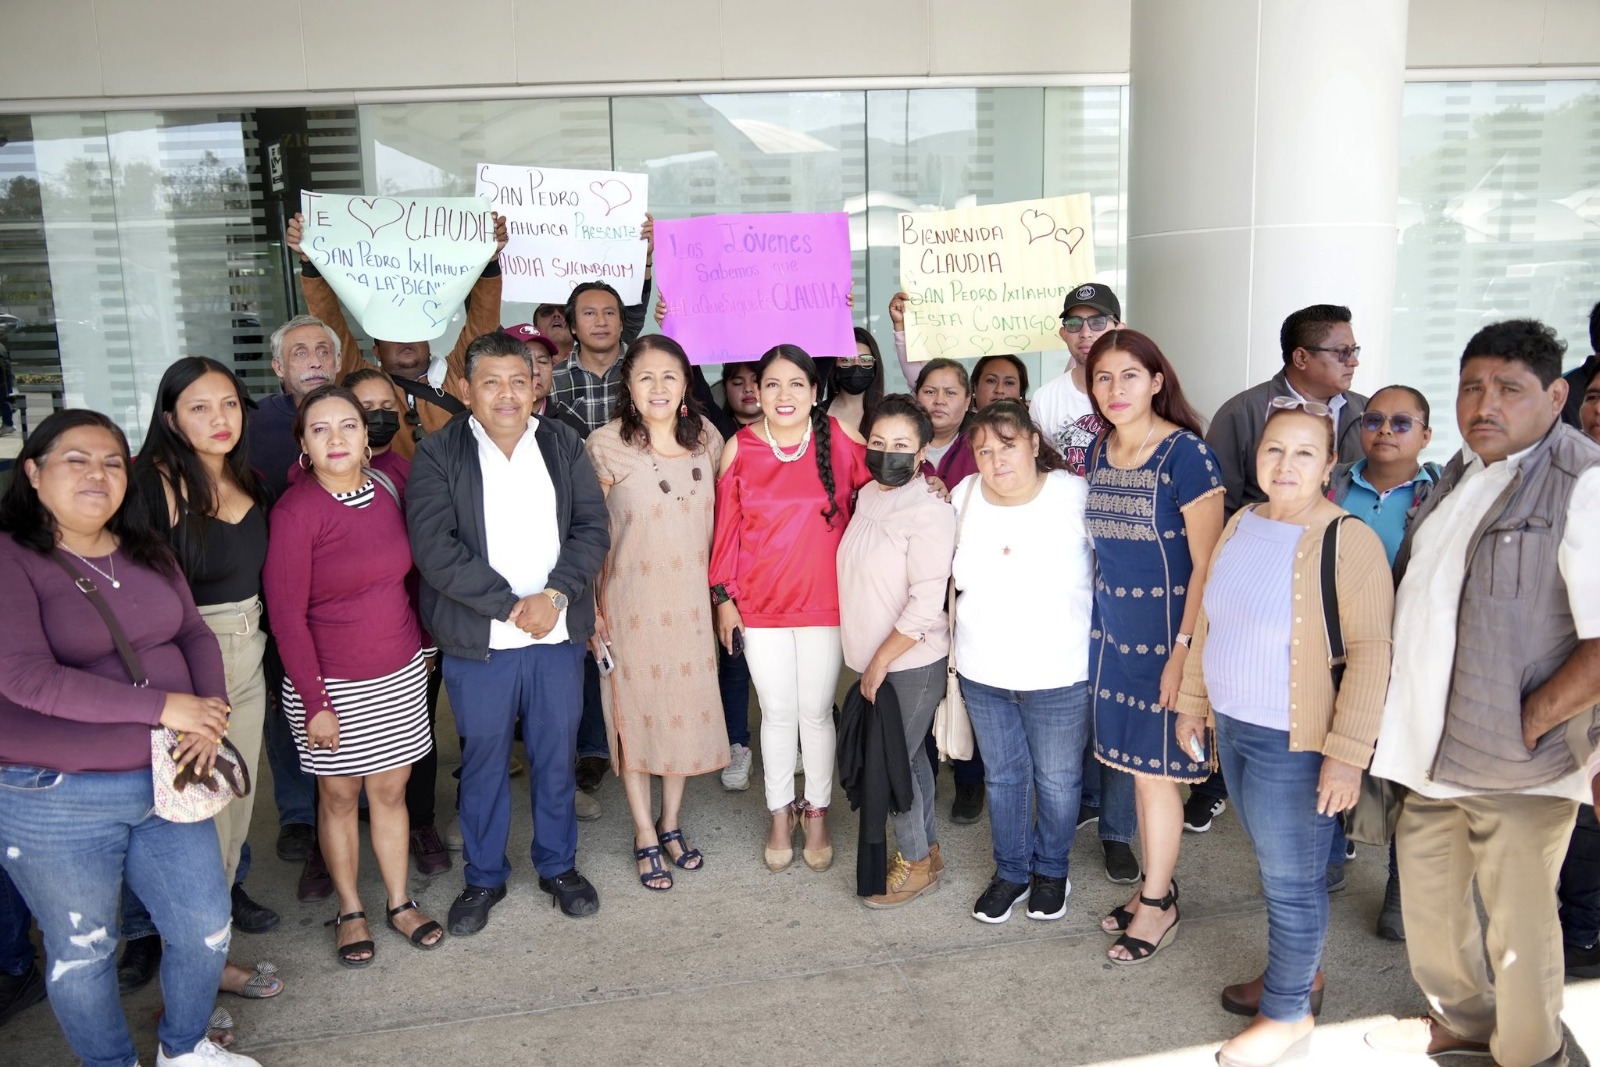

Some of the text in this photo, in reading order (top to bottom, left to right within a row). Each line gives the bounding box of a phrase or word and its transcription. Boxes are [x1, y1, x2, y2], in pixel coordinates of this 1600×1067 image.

[480, 165, 579, 206] SAN PEDRO
[302, 192, 496, 244] TE CLAUDIA
[510, 221, 568, 237] AHUACA
[901, 214, 1004, 246] BIENVENIDA
[312, 236, 353, 268] SAN
[357, 240, 400, 269] PEDRO
[498, 252, 545, 278] AUDIA
[920, 248, 1003, 275] CLAUDIA
[696, 259, 799, 283] Sabemos que
[908, 281, 944, 306] SAN
[949, 280, 998, 303] PEDRO
[911, 305, 1056, 336] ESTA CONTIGO
